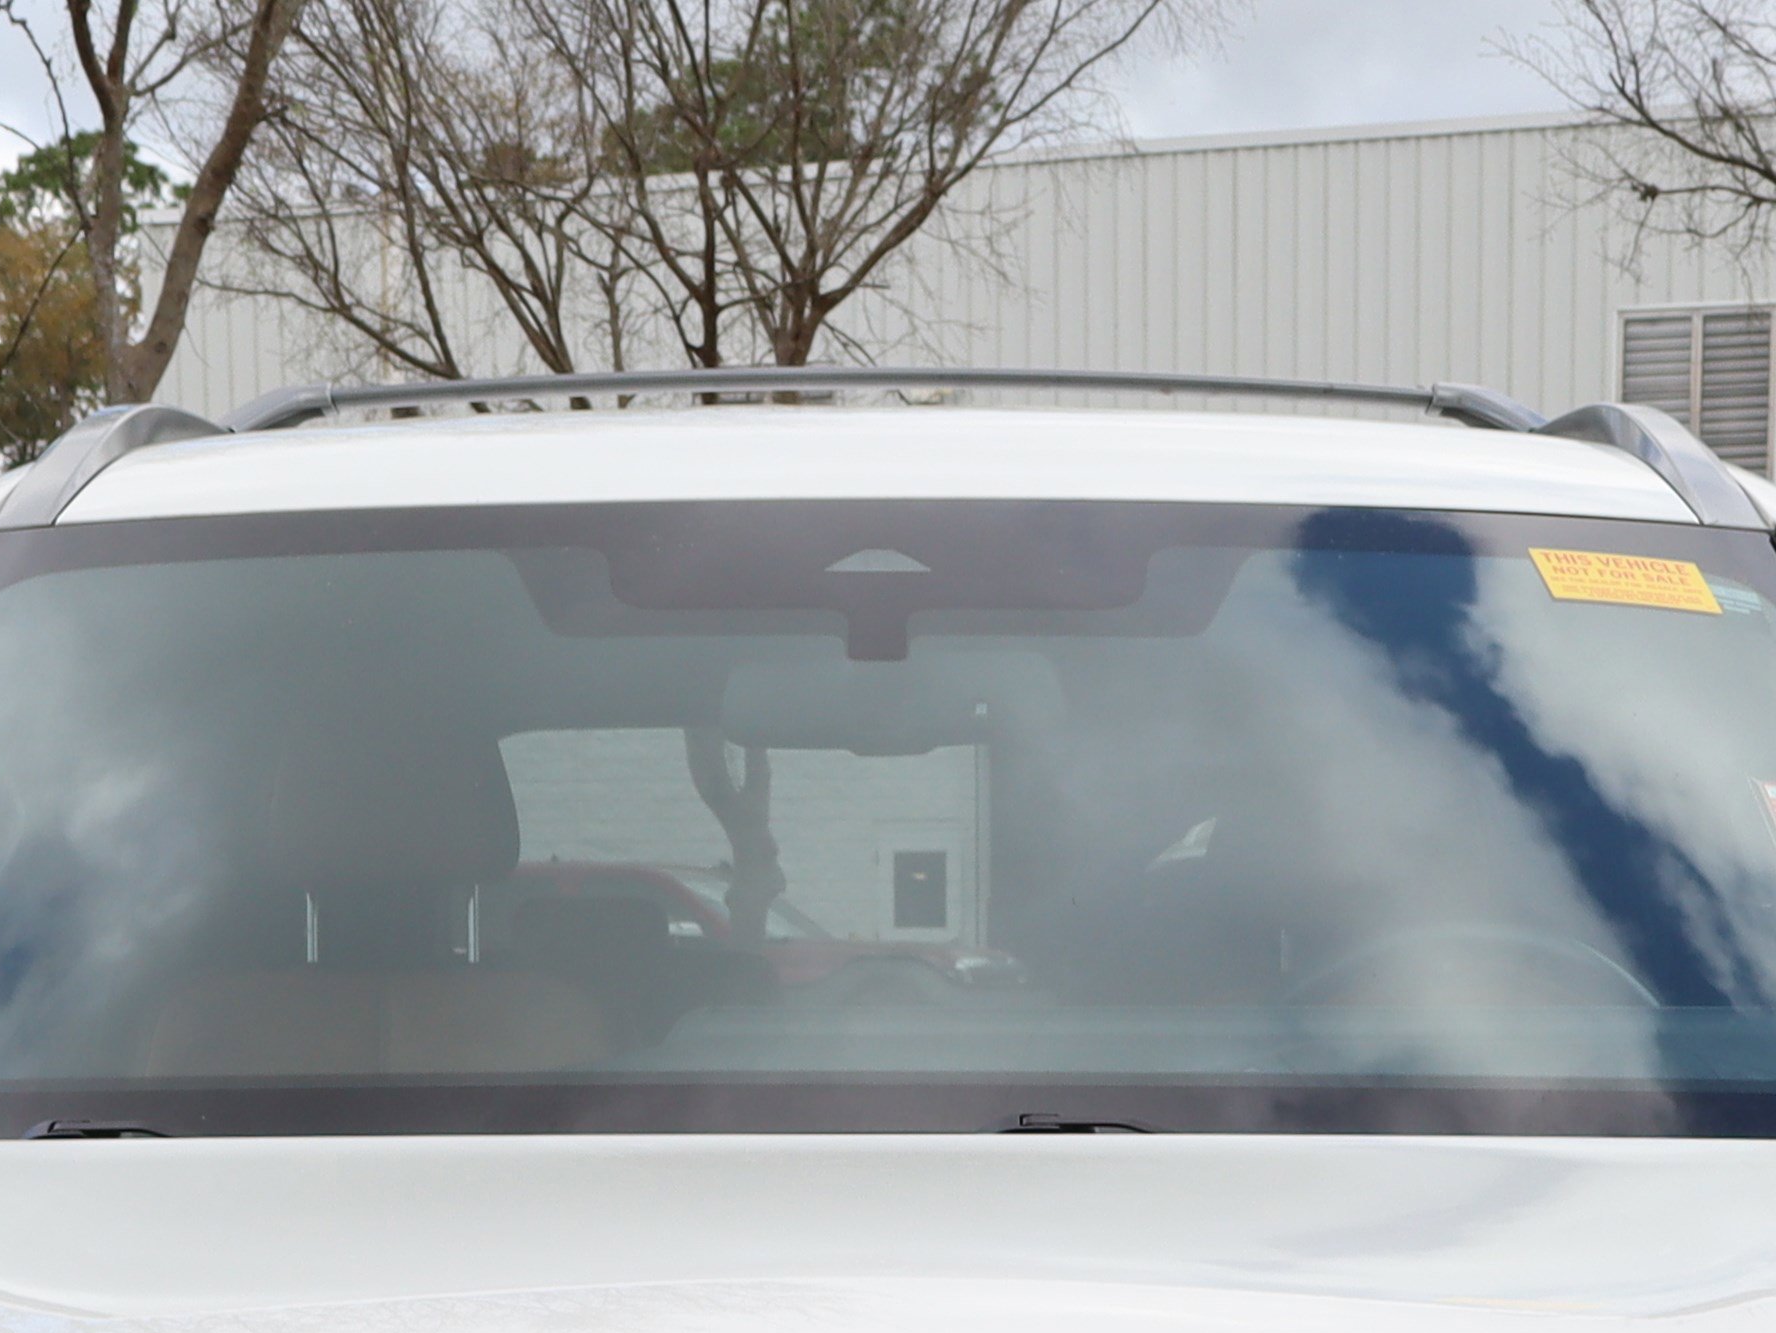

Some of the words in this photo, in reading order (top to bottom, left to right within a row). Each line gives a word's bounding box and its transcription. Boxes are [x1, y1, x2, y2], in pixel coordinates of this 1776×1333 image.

[1541, 552, 1592, 566] THIS
[1596, 556, 1689, 576] VEHICLE
[1552, 565, 1590, 576] NOT
[1597, 569, 1636, 580] FOR
[1642, 573, 1691, 585] SALE
